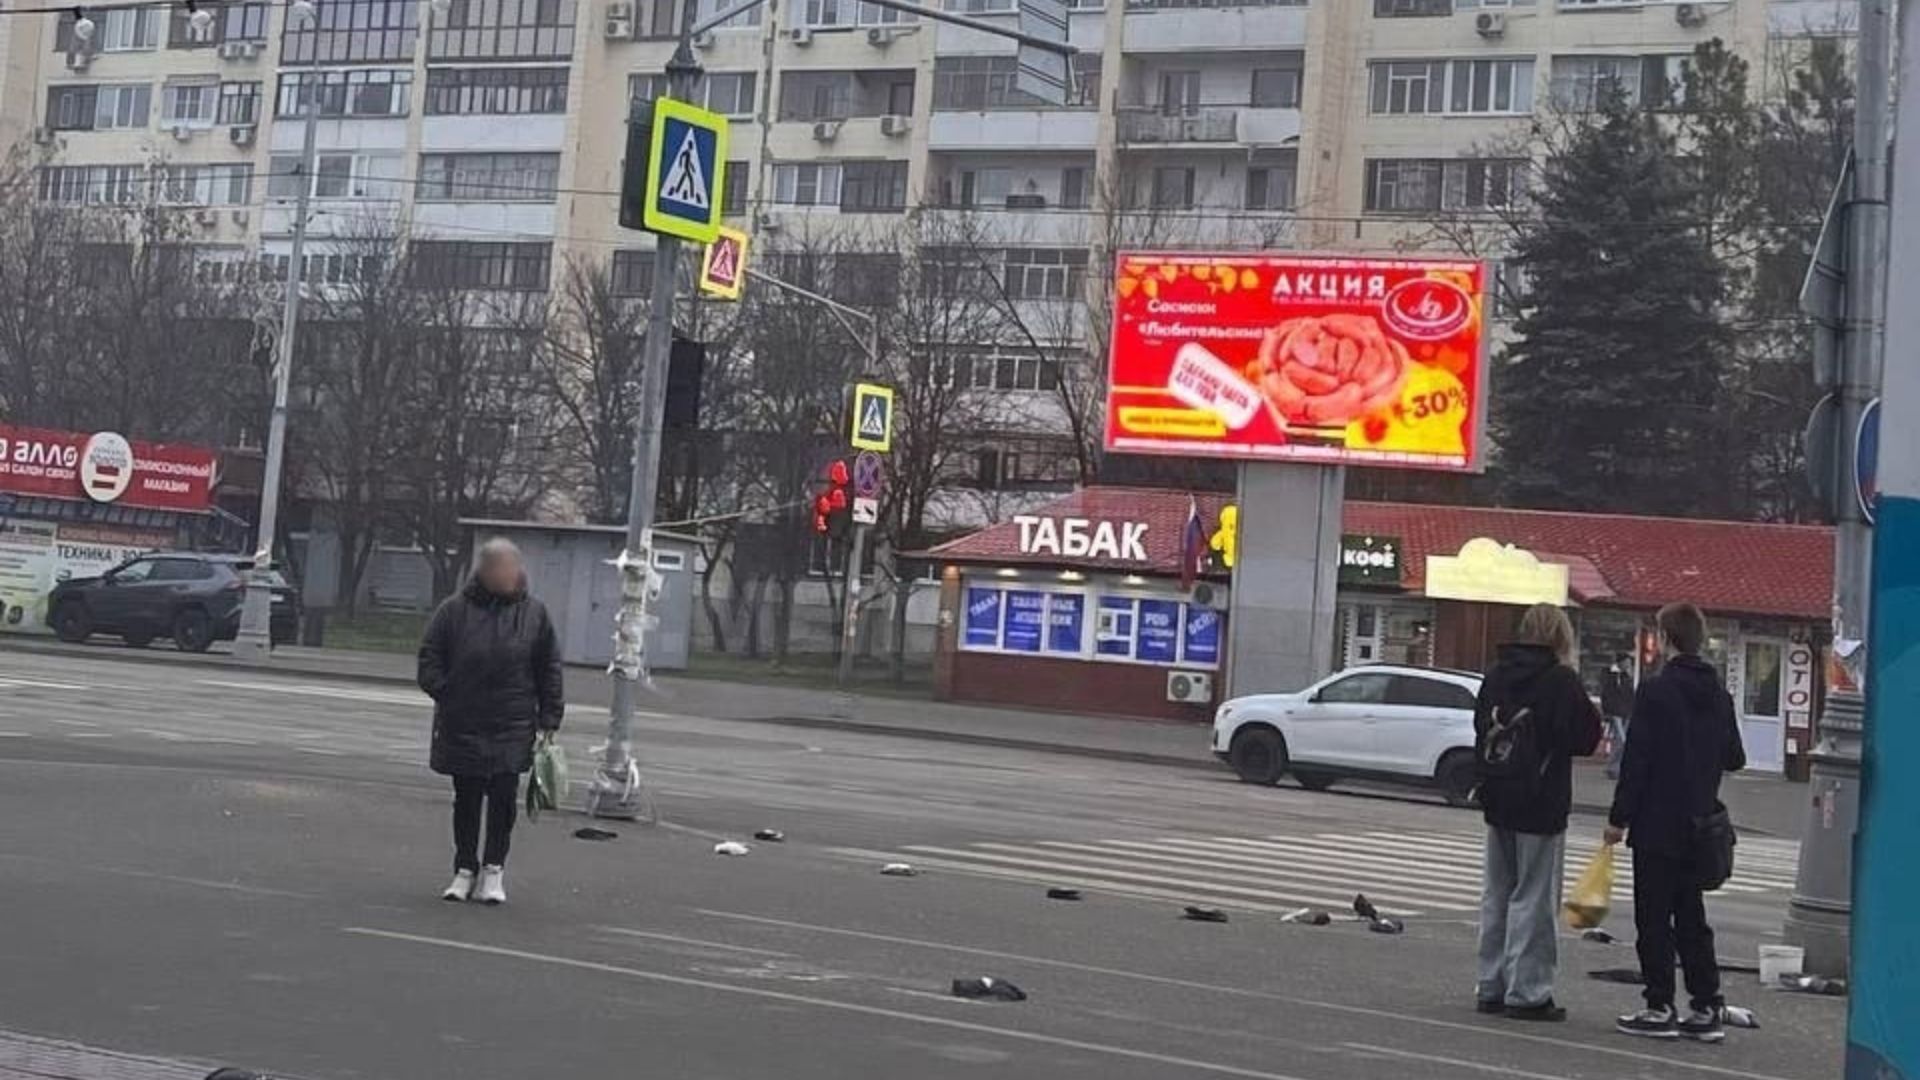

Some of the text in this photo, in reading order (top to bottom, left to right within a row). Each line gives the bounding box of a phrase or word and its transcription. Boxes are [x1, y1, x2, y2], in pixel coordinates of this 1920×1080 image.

[1273, 274, 1385, 297] АКЦИЯ
[1148, 300, 1216, 314] Сосиски
[132, 459, 210, 477] ОМИССИОННЫЙ
[143, 478, 190, 493] МАГАЗИН
[1013, 516, 1149, 560] ТАБАК
[57, 544, 112, 561] ТЕХНИКА
[1344, 549, 1395, 568] КОФЕ
